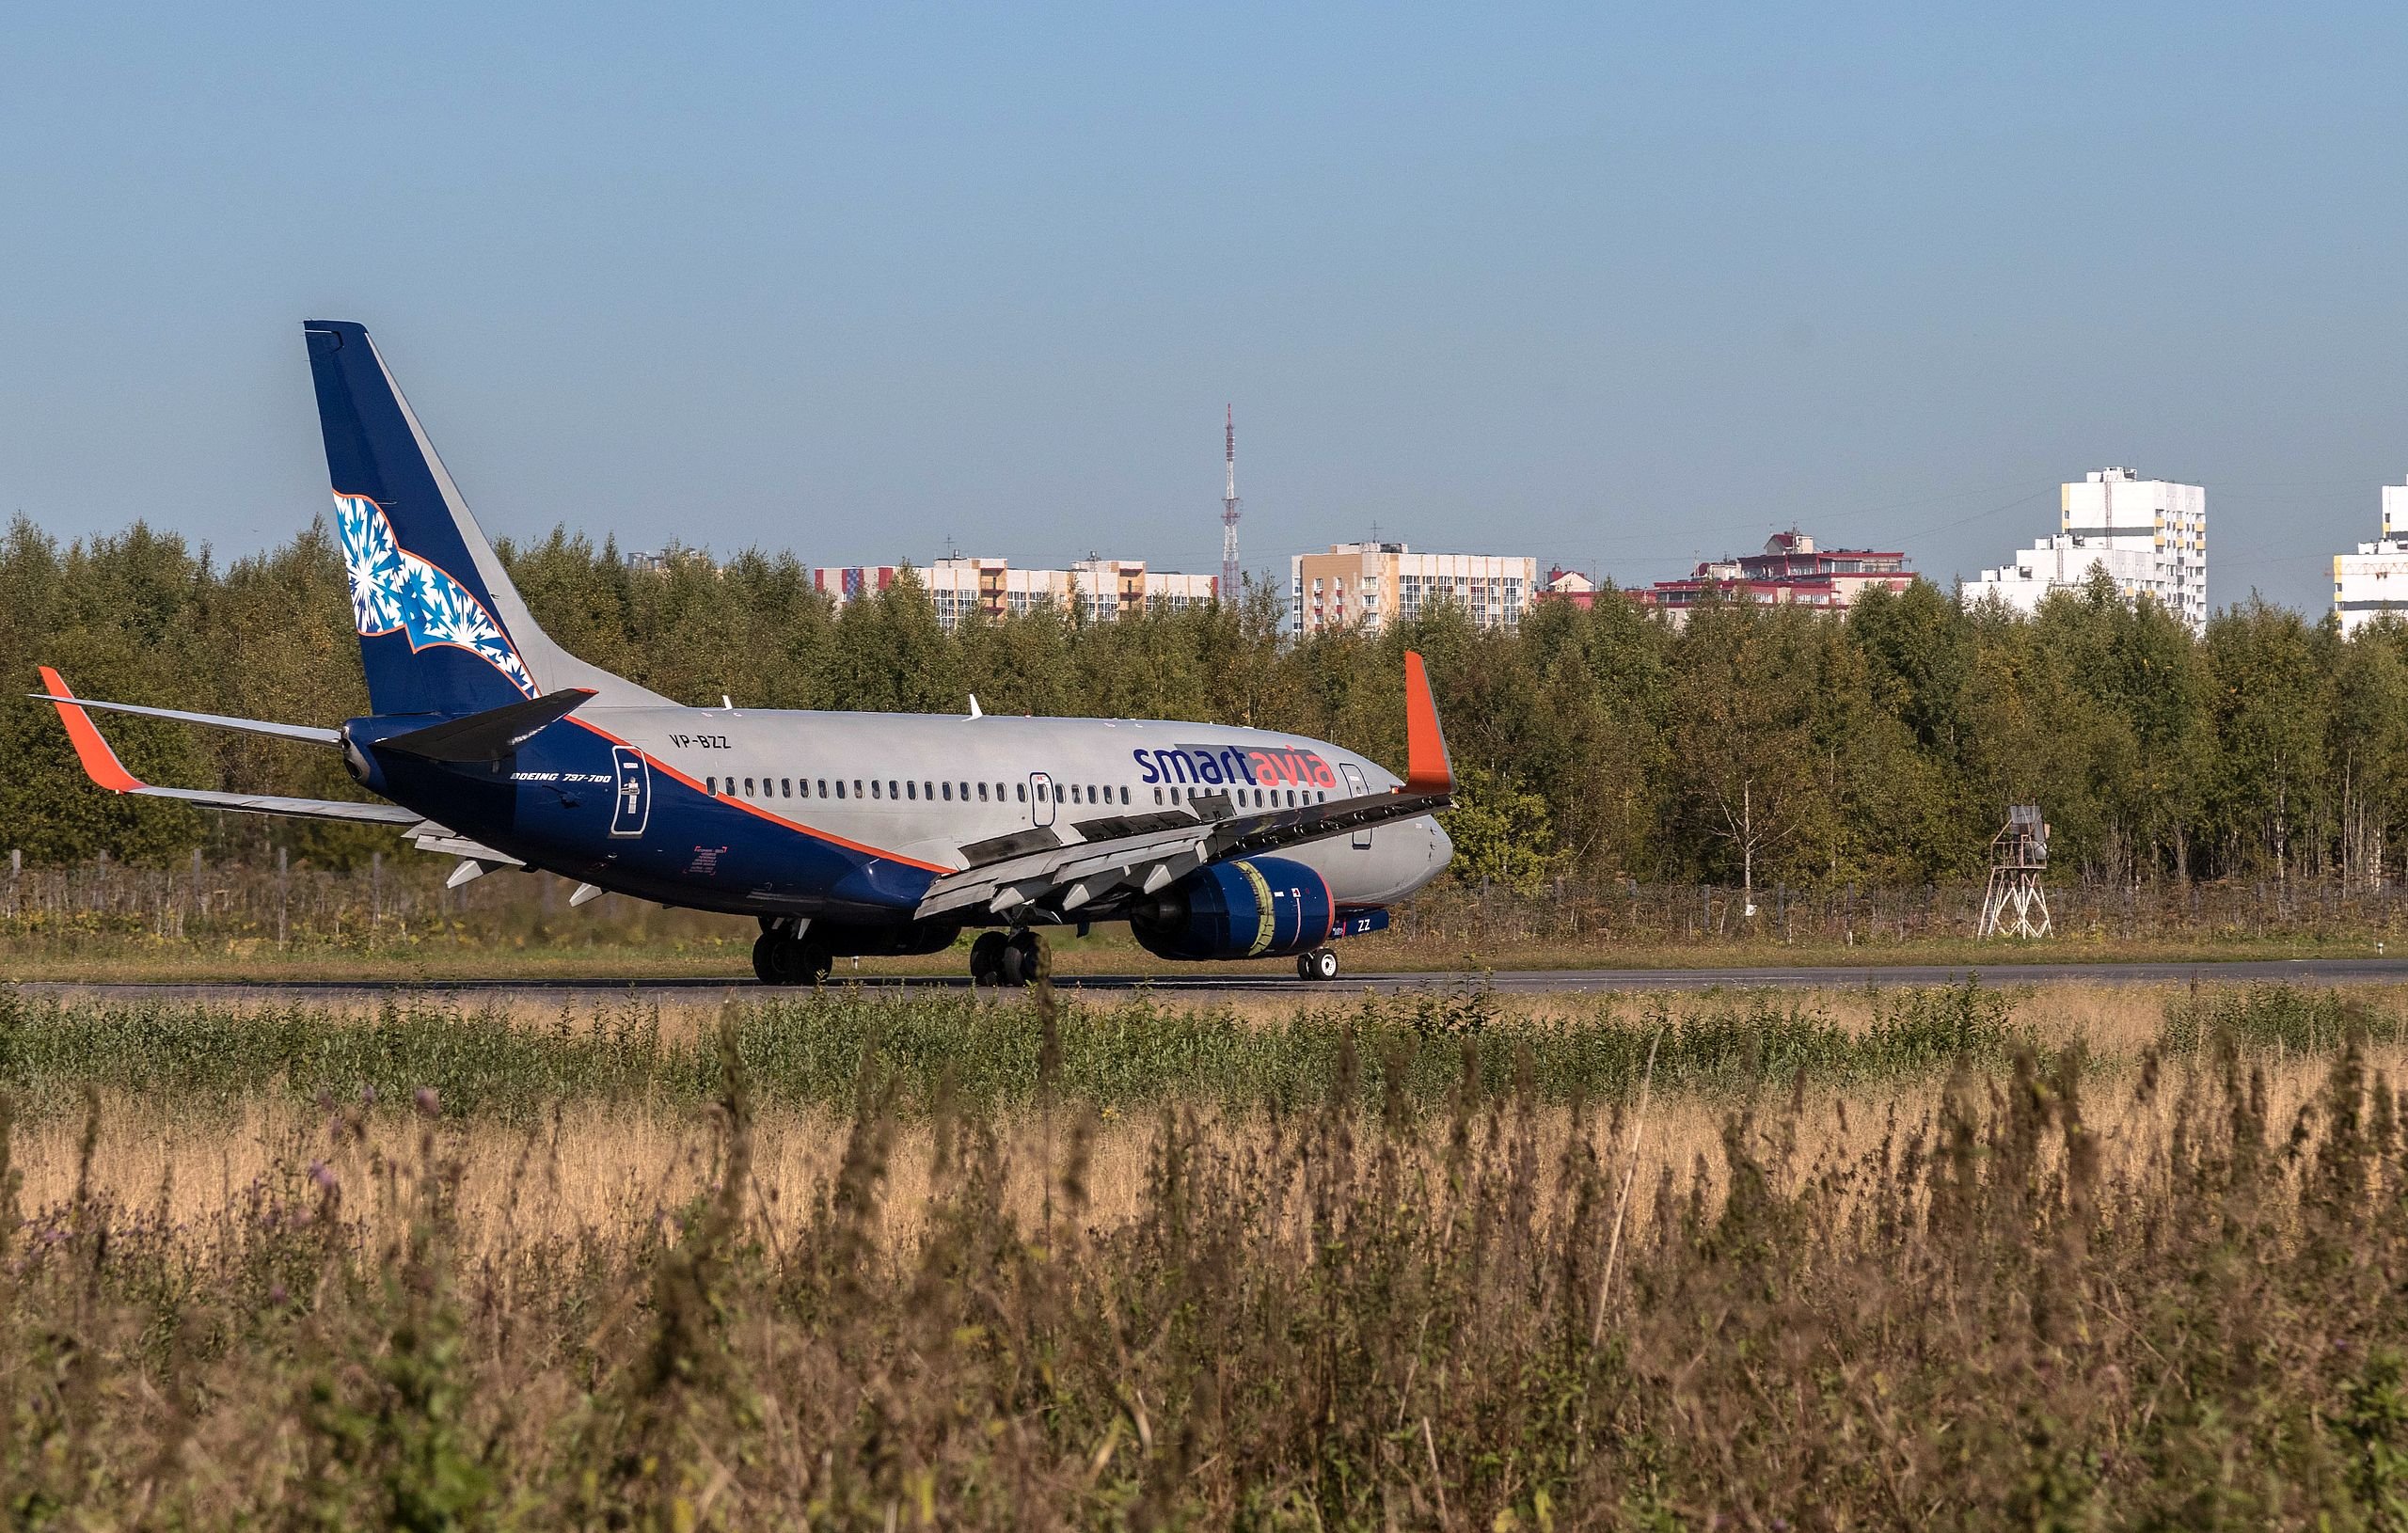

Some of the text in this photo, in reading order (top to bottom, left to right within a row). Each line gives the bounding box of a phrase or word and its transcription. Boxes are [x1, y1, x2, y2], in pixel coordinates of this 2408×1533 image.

[669, 735, 732, 749] VP-BZZ
[1133, 744, 1337, 789] smartavia
[510, 772, 559, 782] BOEING
[1357, 918, 1370, 933] ZZ
